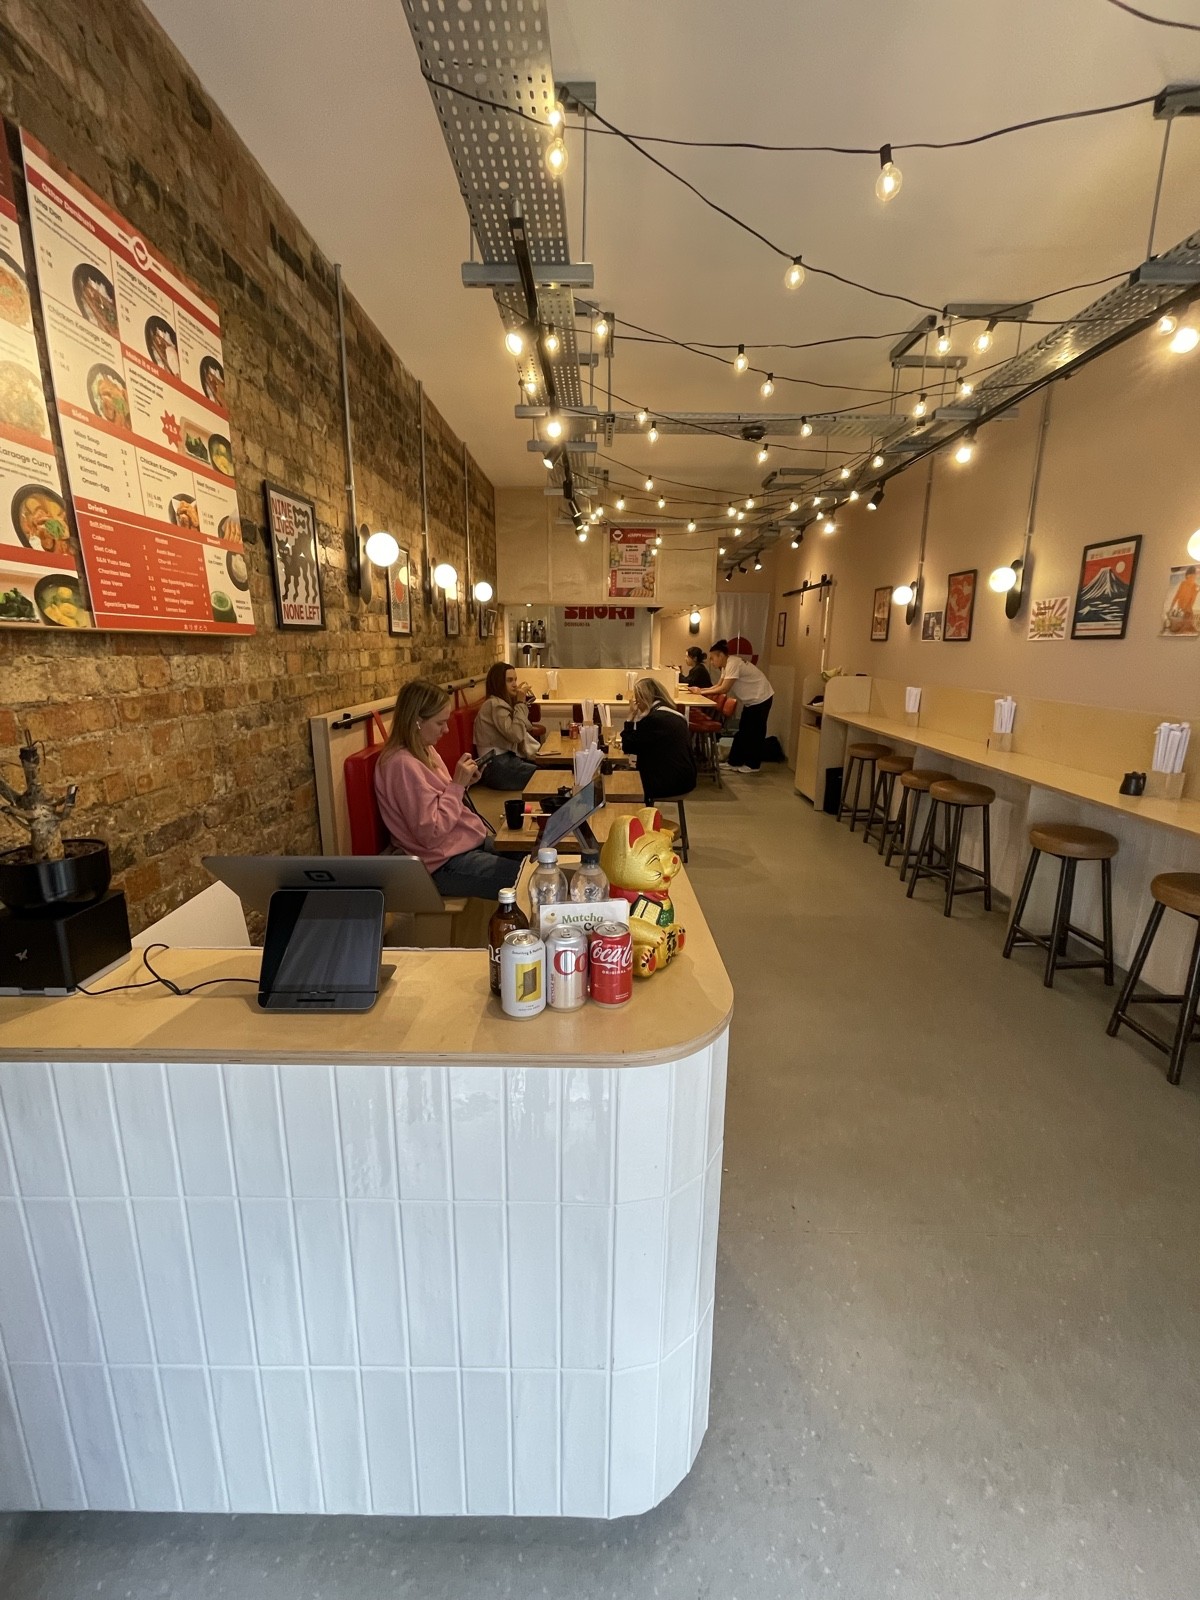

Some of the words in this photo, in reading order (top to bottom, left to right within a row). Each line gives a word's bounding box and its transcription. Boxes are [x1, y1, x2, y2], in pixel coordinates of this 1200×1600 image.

[42, 182, 63, 206] Other
[64, 200, 96, 233] Donburis
[49, 206, 62, 222] Don
[100, 337, 113, 350] Don
[71, 408, 89, 422] Sides
[75, 441, 93, 454] Potato
[31, 457, 52, 472] Curry
[139, 455, 158, 469] Chicken
[87, 502, 108, 515] Drinks
[271, 497, 293, 520] NINE
[274, 517, 295, 537] LIVES
[91, 533, 105, 542] Coke
[93, 544, 104, 552] Diet
[104, 546, 117, 555] Coke
[283, 603, 304, 620] NONE
[305, 604, 320, 620] LEFT
[564, 606, 635, 620] SHORI
[562, 912, 604, 924] Matcha
